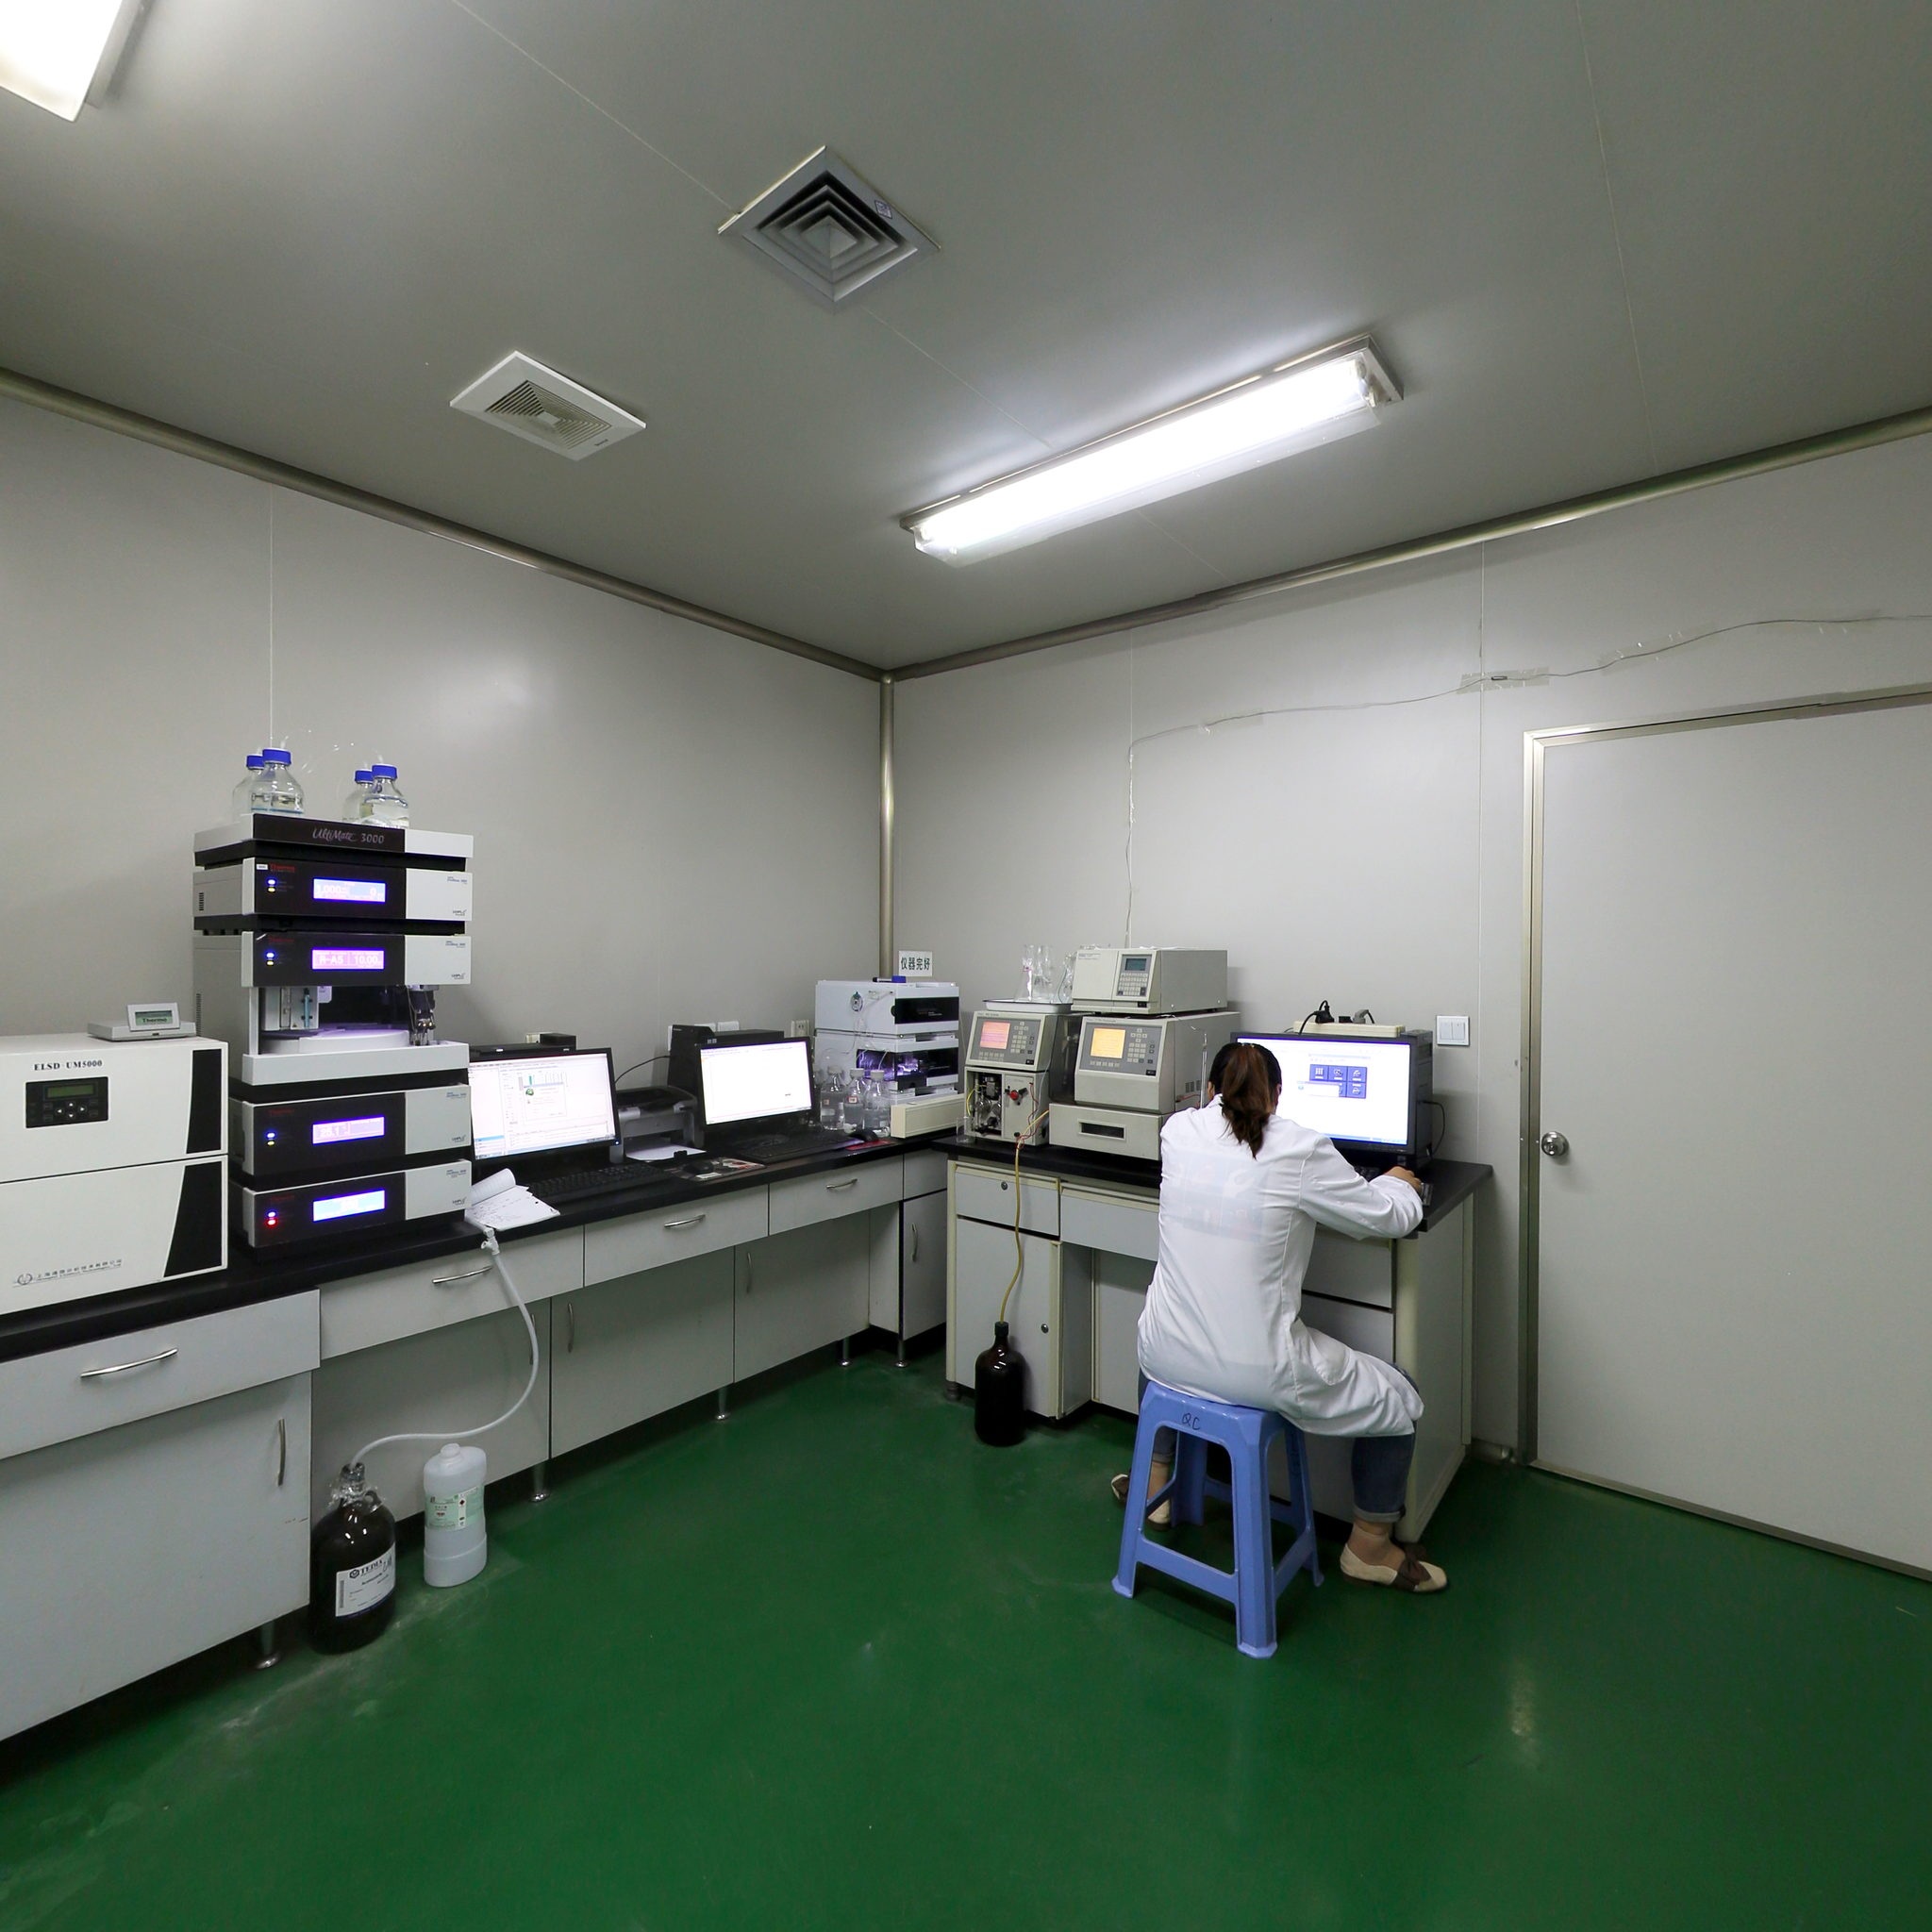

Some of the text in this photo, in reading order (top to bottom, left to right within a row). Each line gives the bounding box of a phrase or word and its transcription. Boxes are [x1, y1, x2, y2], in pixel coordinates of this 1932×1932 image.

[312, 827, 385, 844] UltiMate 3000
[900, 956, 930, 971] 仪器完好
[34, 1059, 103, 1071] ELSD UM5000
[1181, 1412, 1201, 1431] QC
